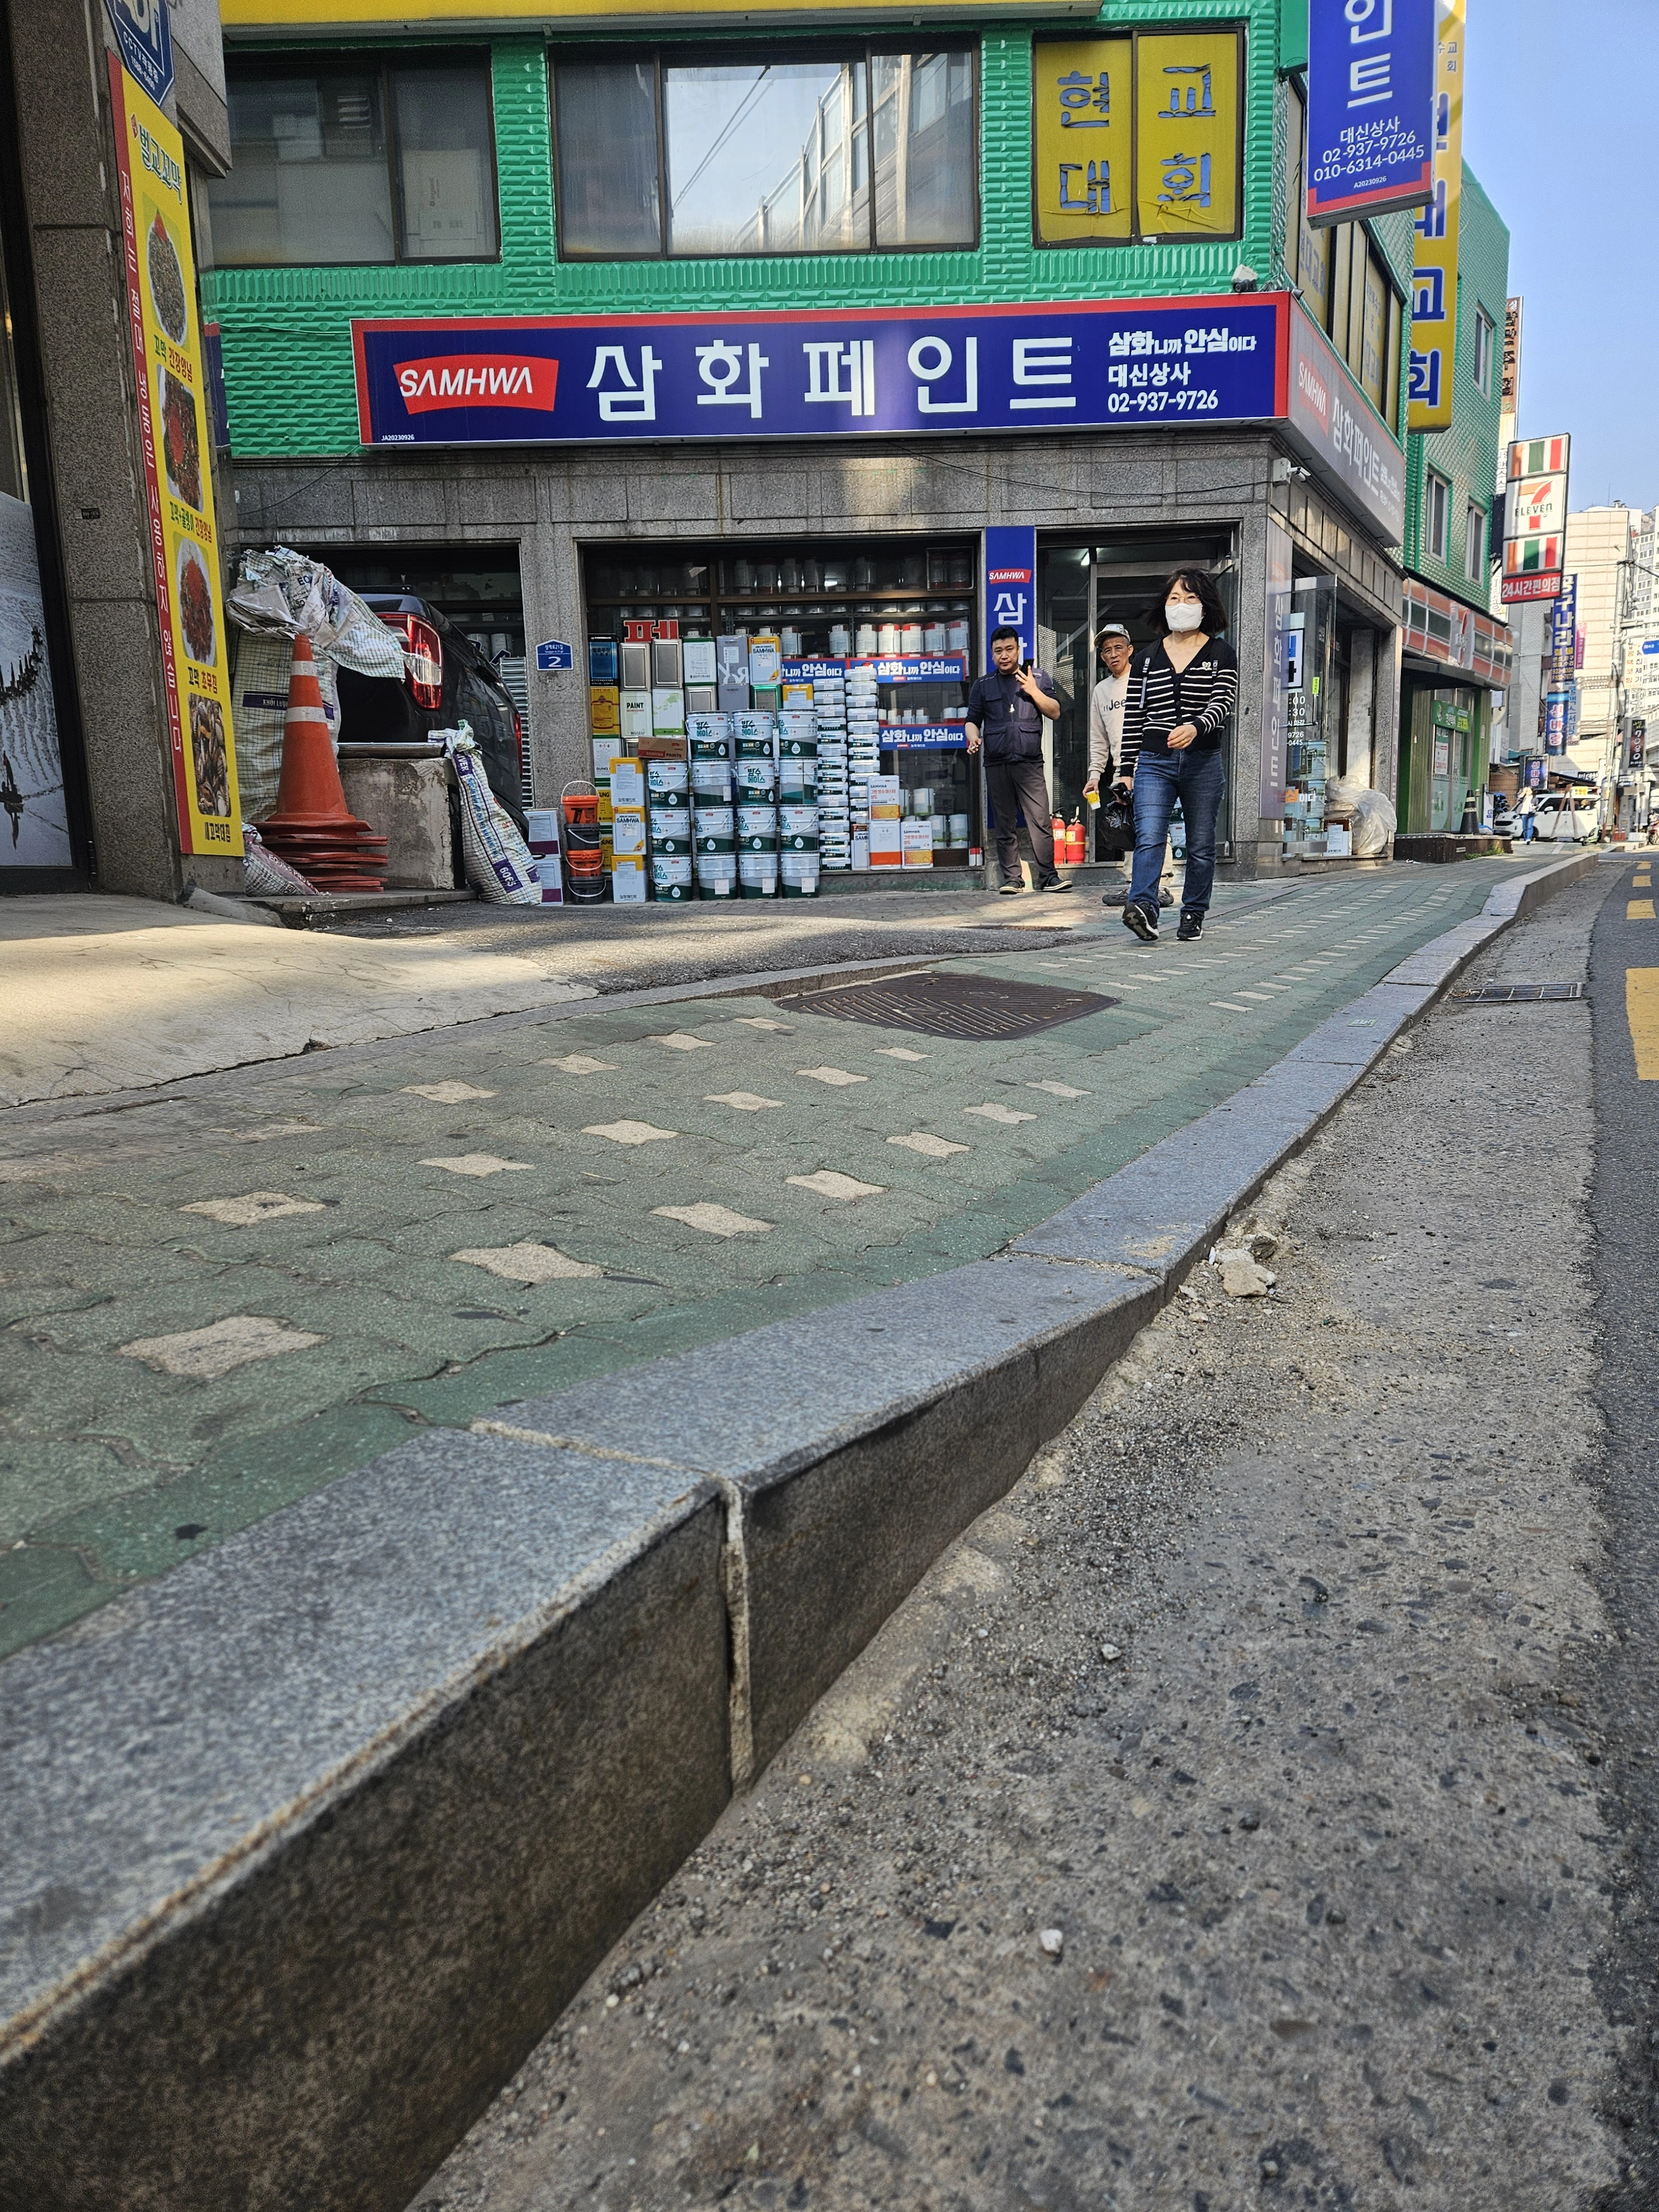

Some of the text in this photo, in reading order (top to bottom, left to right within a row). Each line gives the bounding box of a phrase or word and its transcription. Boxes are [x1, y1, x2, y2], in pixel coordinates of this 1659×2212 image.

[1340, 115, 1400, 144] 대신상사
[1323, 129, 1416, 164] 02-937-9726
[1313, 144, 1425, 182] 010-6314-0445
[1109, 327, 1257, 357] 삼화니까 안심이다
[399, 366, 533, 398] SAMHWA
[586, 336, 1077, 421] 삼화페인트
[1108, 361, 1191, 388] 대신상사
[1108, 389, 1218, 413] 02-937-9726
[1298, 361, 1327, 418] SAMHWA
[1333, 396, 1380, 497] 삼화페인트
[989, 571, 1025, 580] SAMHWA
[1502, 576, 1561, 598] 24시간편의점
[624, 619, 679, 643] 페
[548, 656, 562, 667] 2
[802, 663, 842, 677] 안심이다
[878, 661, 961, 676] 삼화니까 안심이다
[696, 721, 710, 729] 방수
[742, 720, 755, 729] 방수
[881, 728, 964, 743] 삼화니까 안심이다
